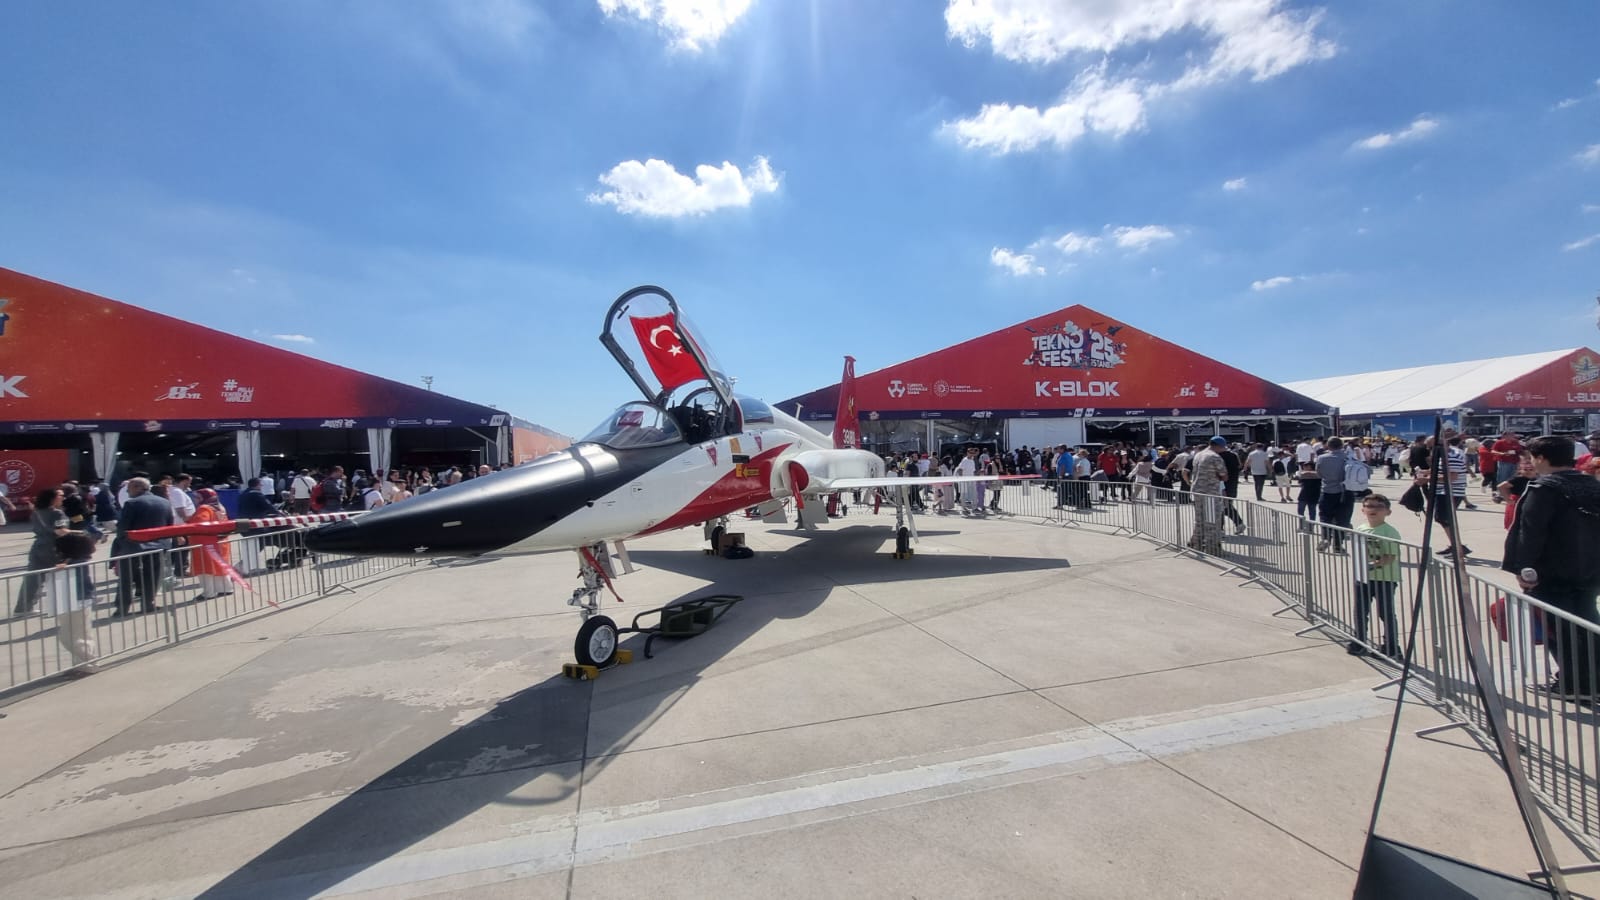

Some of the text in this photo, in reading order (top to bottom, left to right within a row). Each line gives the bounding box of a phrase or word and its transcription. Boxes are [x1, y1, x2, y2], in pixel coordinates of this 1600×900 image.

[1032, 333, 1084, 351] TEKNO
[1041, 349, 1083, 367] FEST
[1035, 381, 1120, 397] K-BLOK
